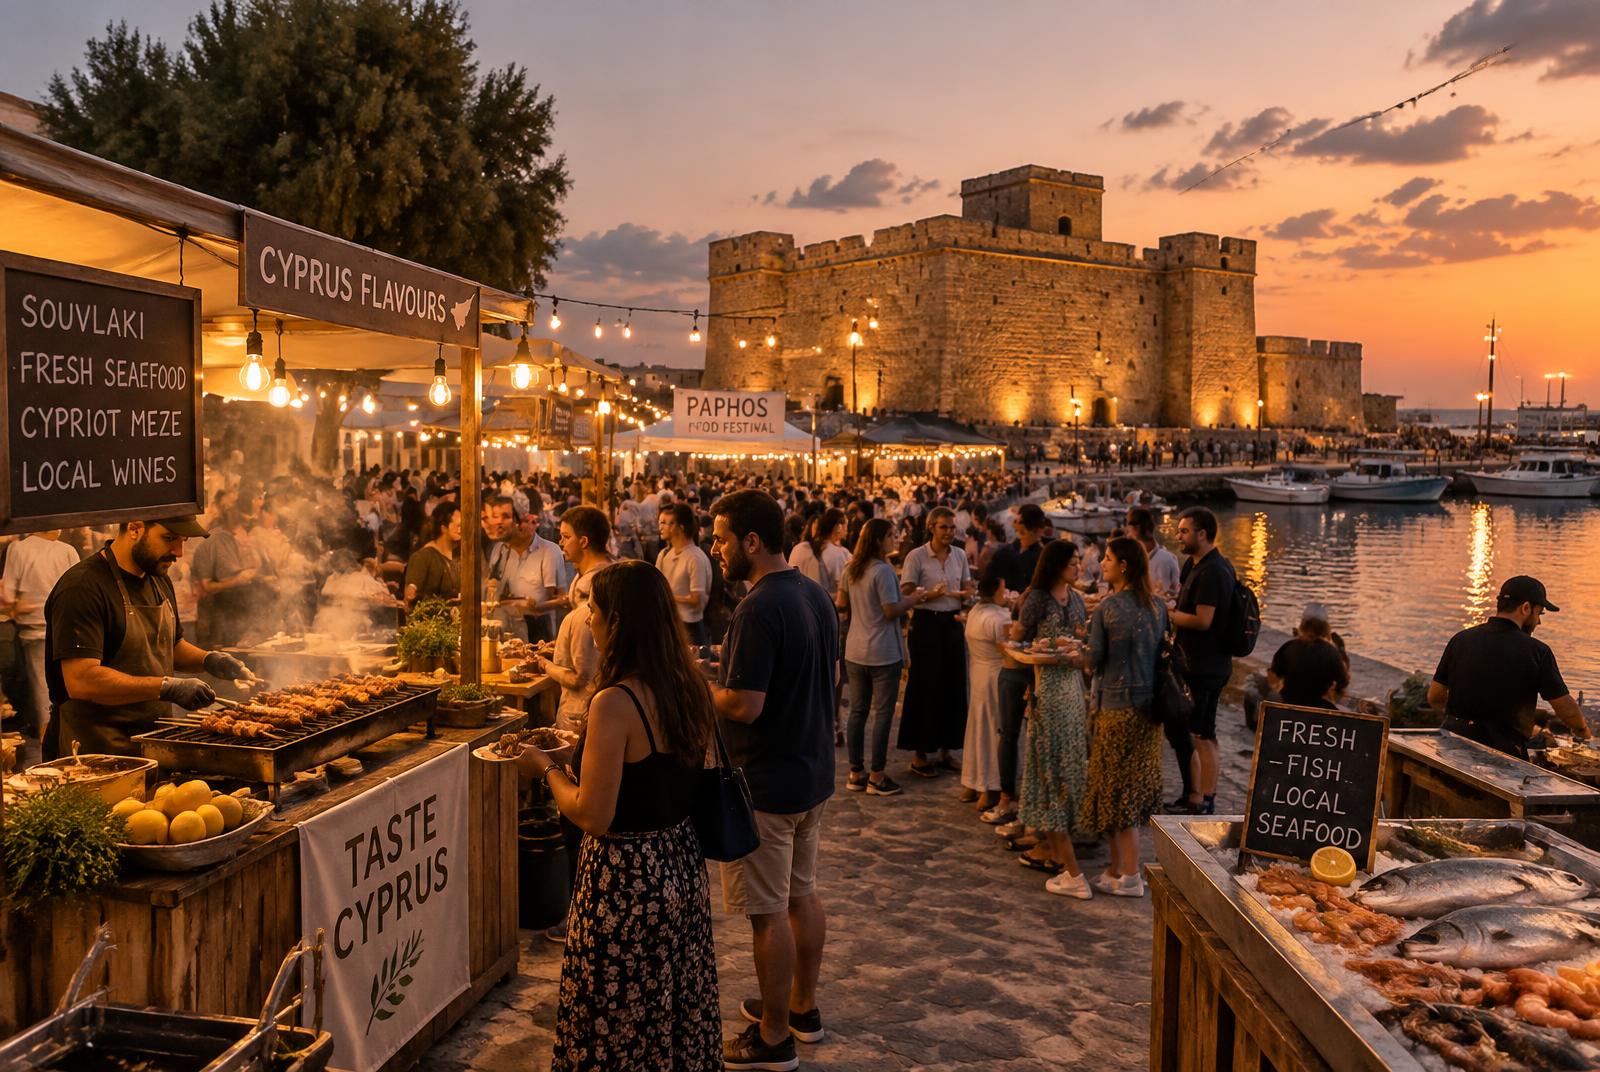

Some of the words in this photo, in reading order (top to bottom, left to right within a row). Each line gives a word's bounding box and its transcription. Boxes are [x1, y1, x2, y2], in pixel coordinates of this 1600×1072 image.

[259, 245, 353, 302] CYPRUS
[361, 273, 446, 323] FLAVOURS
[21, 294, 144, 340] SOUVLAKI
[20, 352, 93, 385] FRESH
[20, 406, 121, 439] CYPRIOT
[131, 410, 182, 437] MEZE
[687, 397, 768, 417] PAPHOS
[723, 422, 775, 434] FESTIVAL
[23, 460, 101, 493] LOCAL
[111, 456, 177, 486] WINES
[1278, 720, 1356, 750] FRESH
[1272, 783, 1346, 815] LOCAL
[345, 793, 437, 888] TASTE
[1256, 812, 1362, 850] SEAFOOD
[333, 847, 448, 960] CYPRUS
